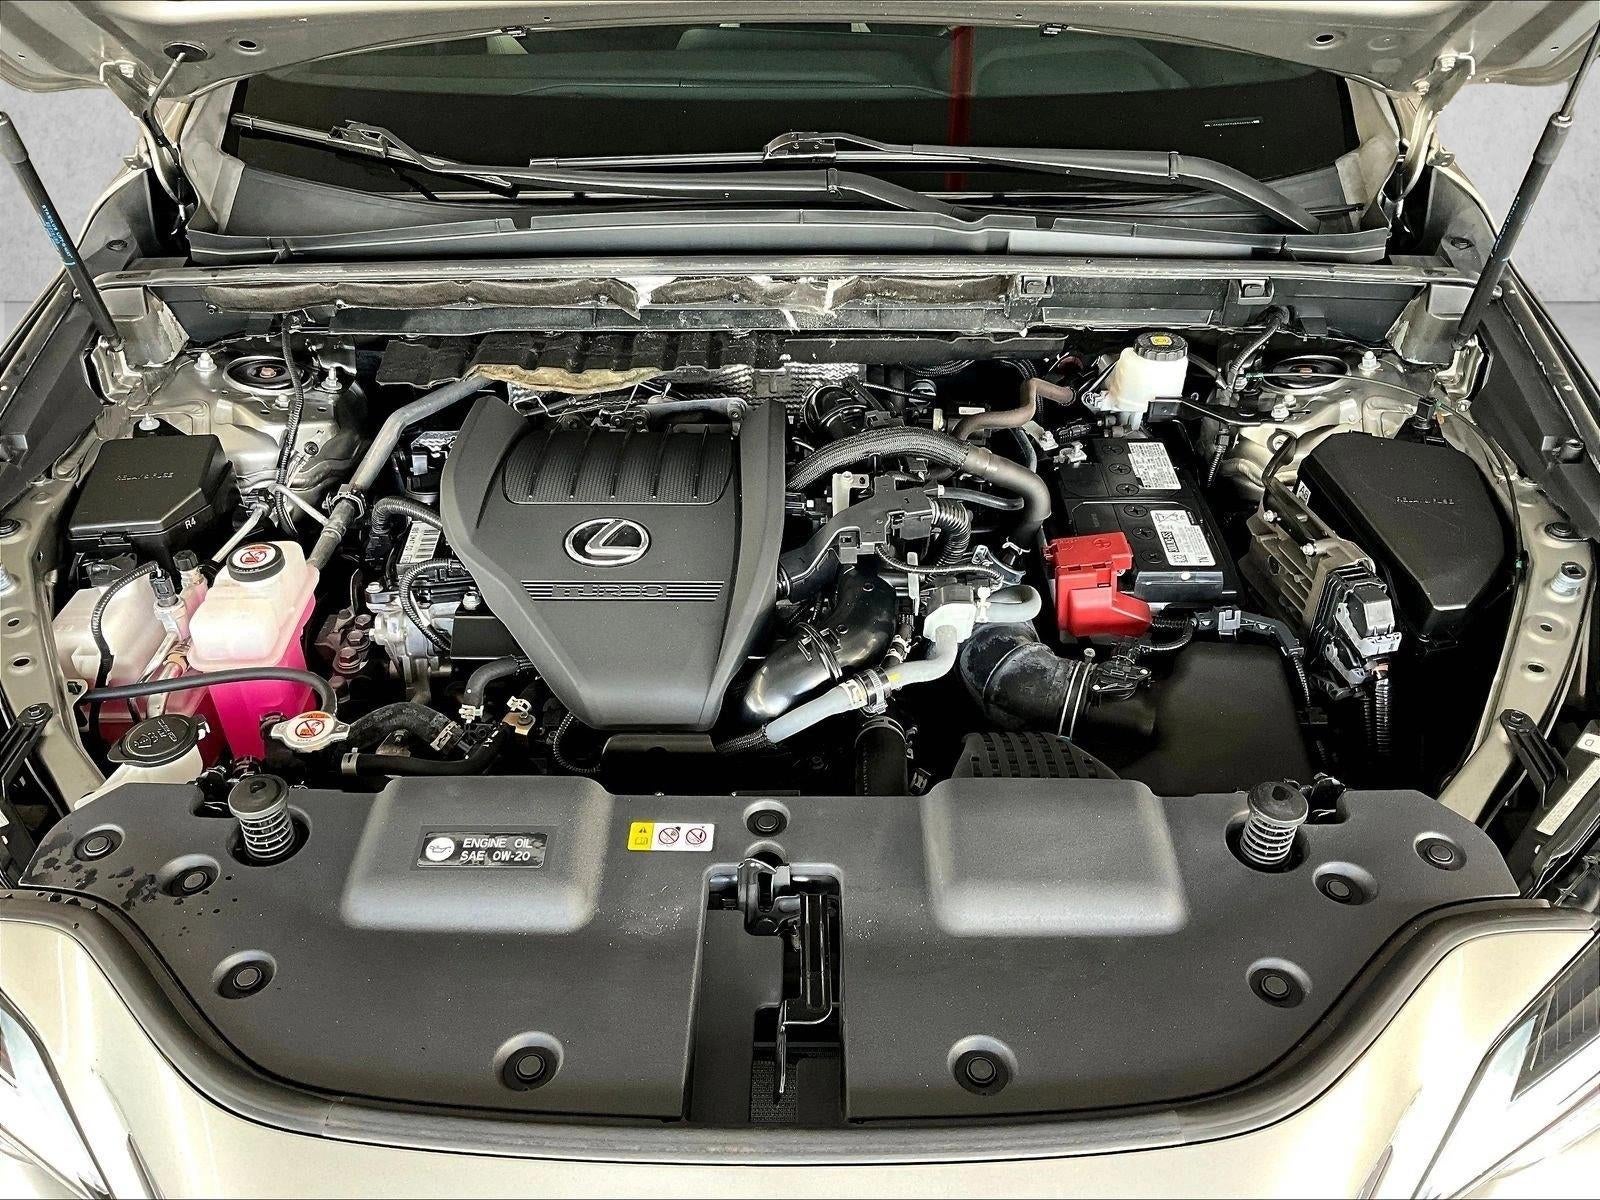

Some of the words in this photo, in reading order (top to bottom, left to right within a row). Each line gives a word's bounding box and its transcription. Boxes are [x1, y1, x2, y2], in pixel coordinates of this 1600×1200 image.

[184, 516, 197, 530] R4
[555, 584, 664, 598] TURBO
[462, 837, 507, 849] ENGINE
[514, 838, 533, 849] OIL
[460, 850, 486, 861] SAE
[492, 850, 531, 861] 0W-20
